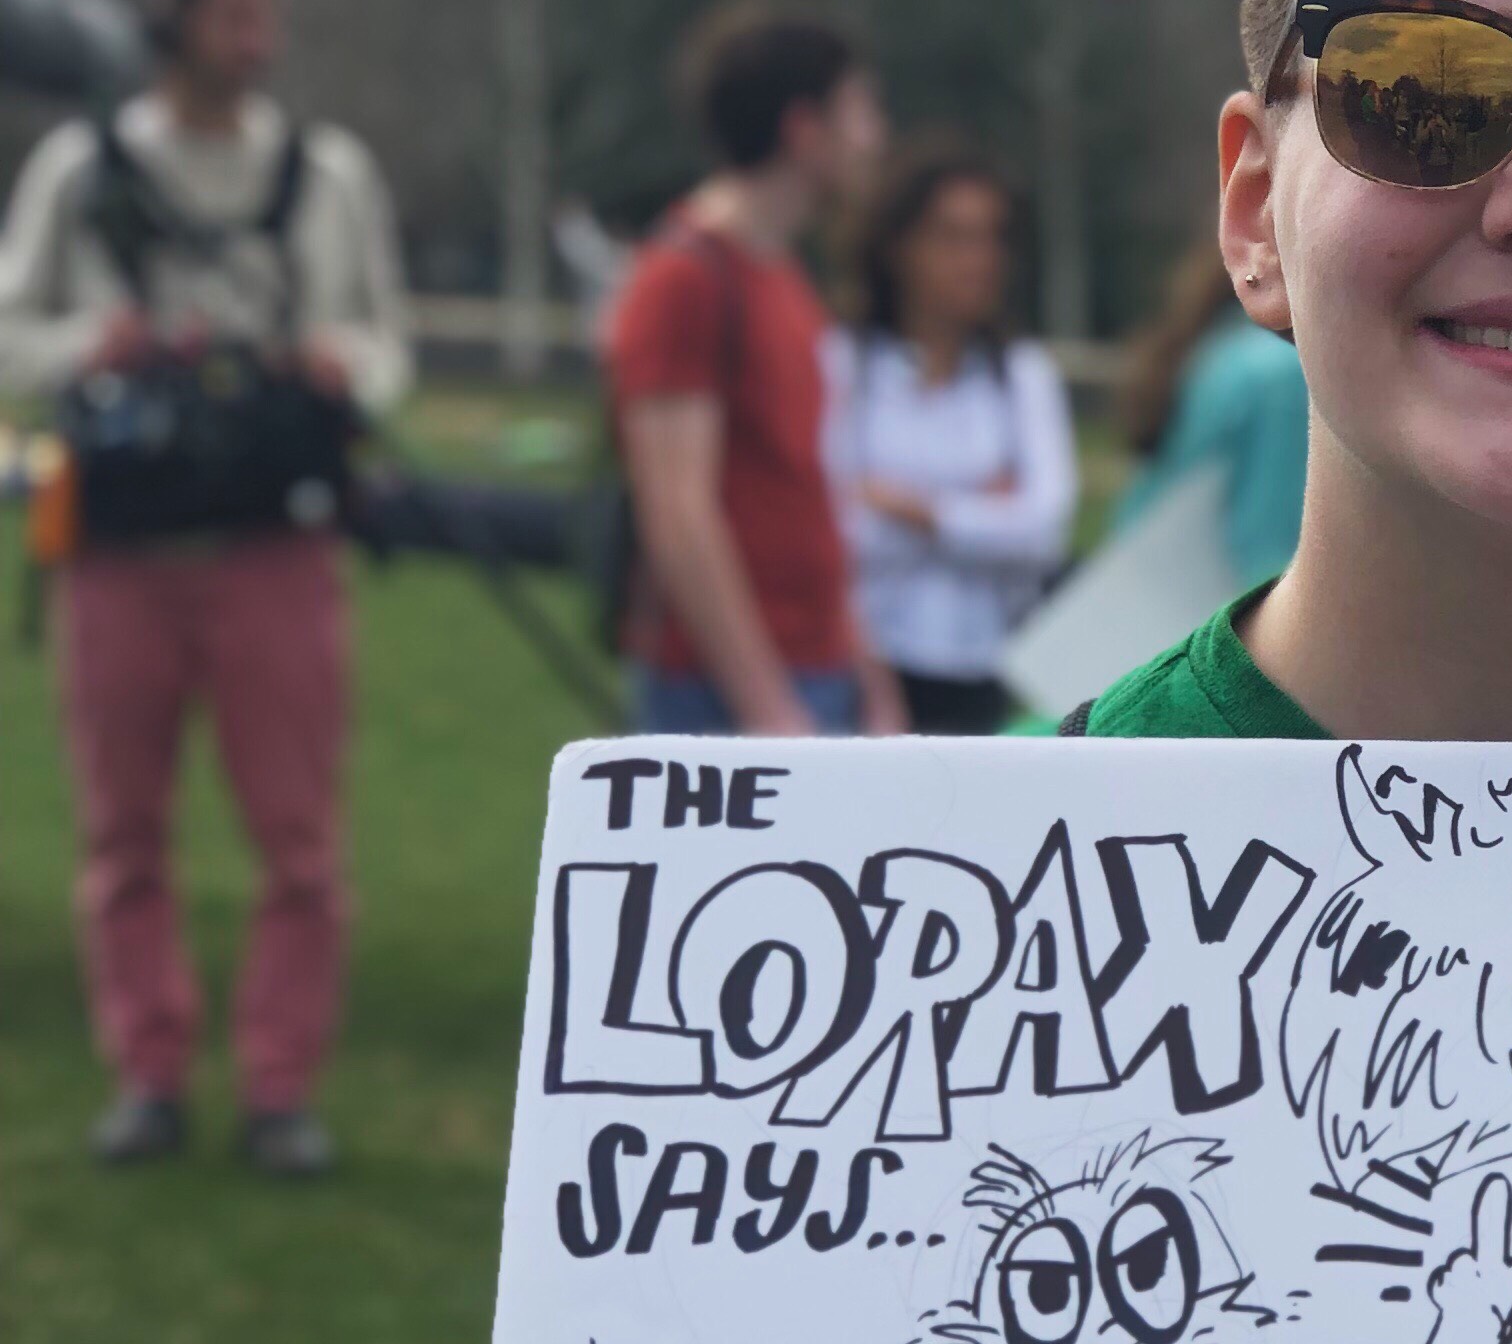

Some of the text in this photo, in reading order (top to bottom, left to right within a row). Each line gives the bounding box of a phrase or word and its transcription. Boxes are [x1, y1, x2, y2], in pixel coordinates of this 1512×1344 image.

[582, 758, 791, 830] THE
[545, 819, 1316, 1142] LORAX
[557, 1123, 945, 1259] SAYS...
